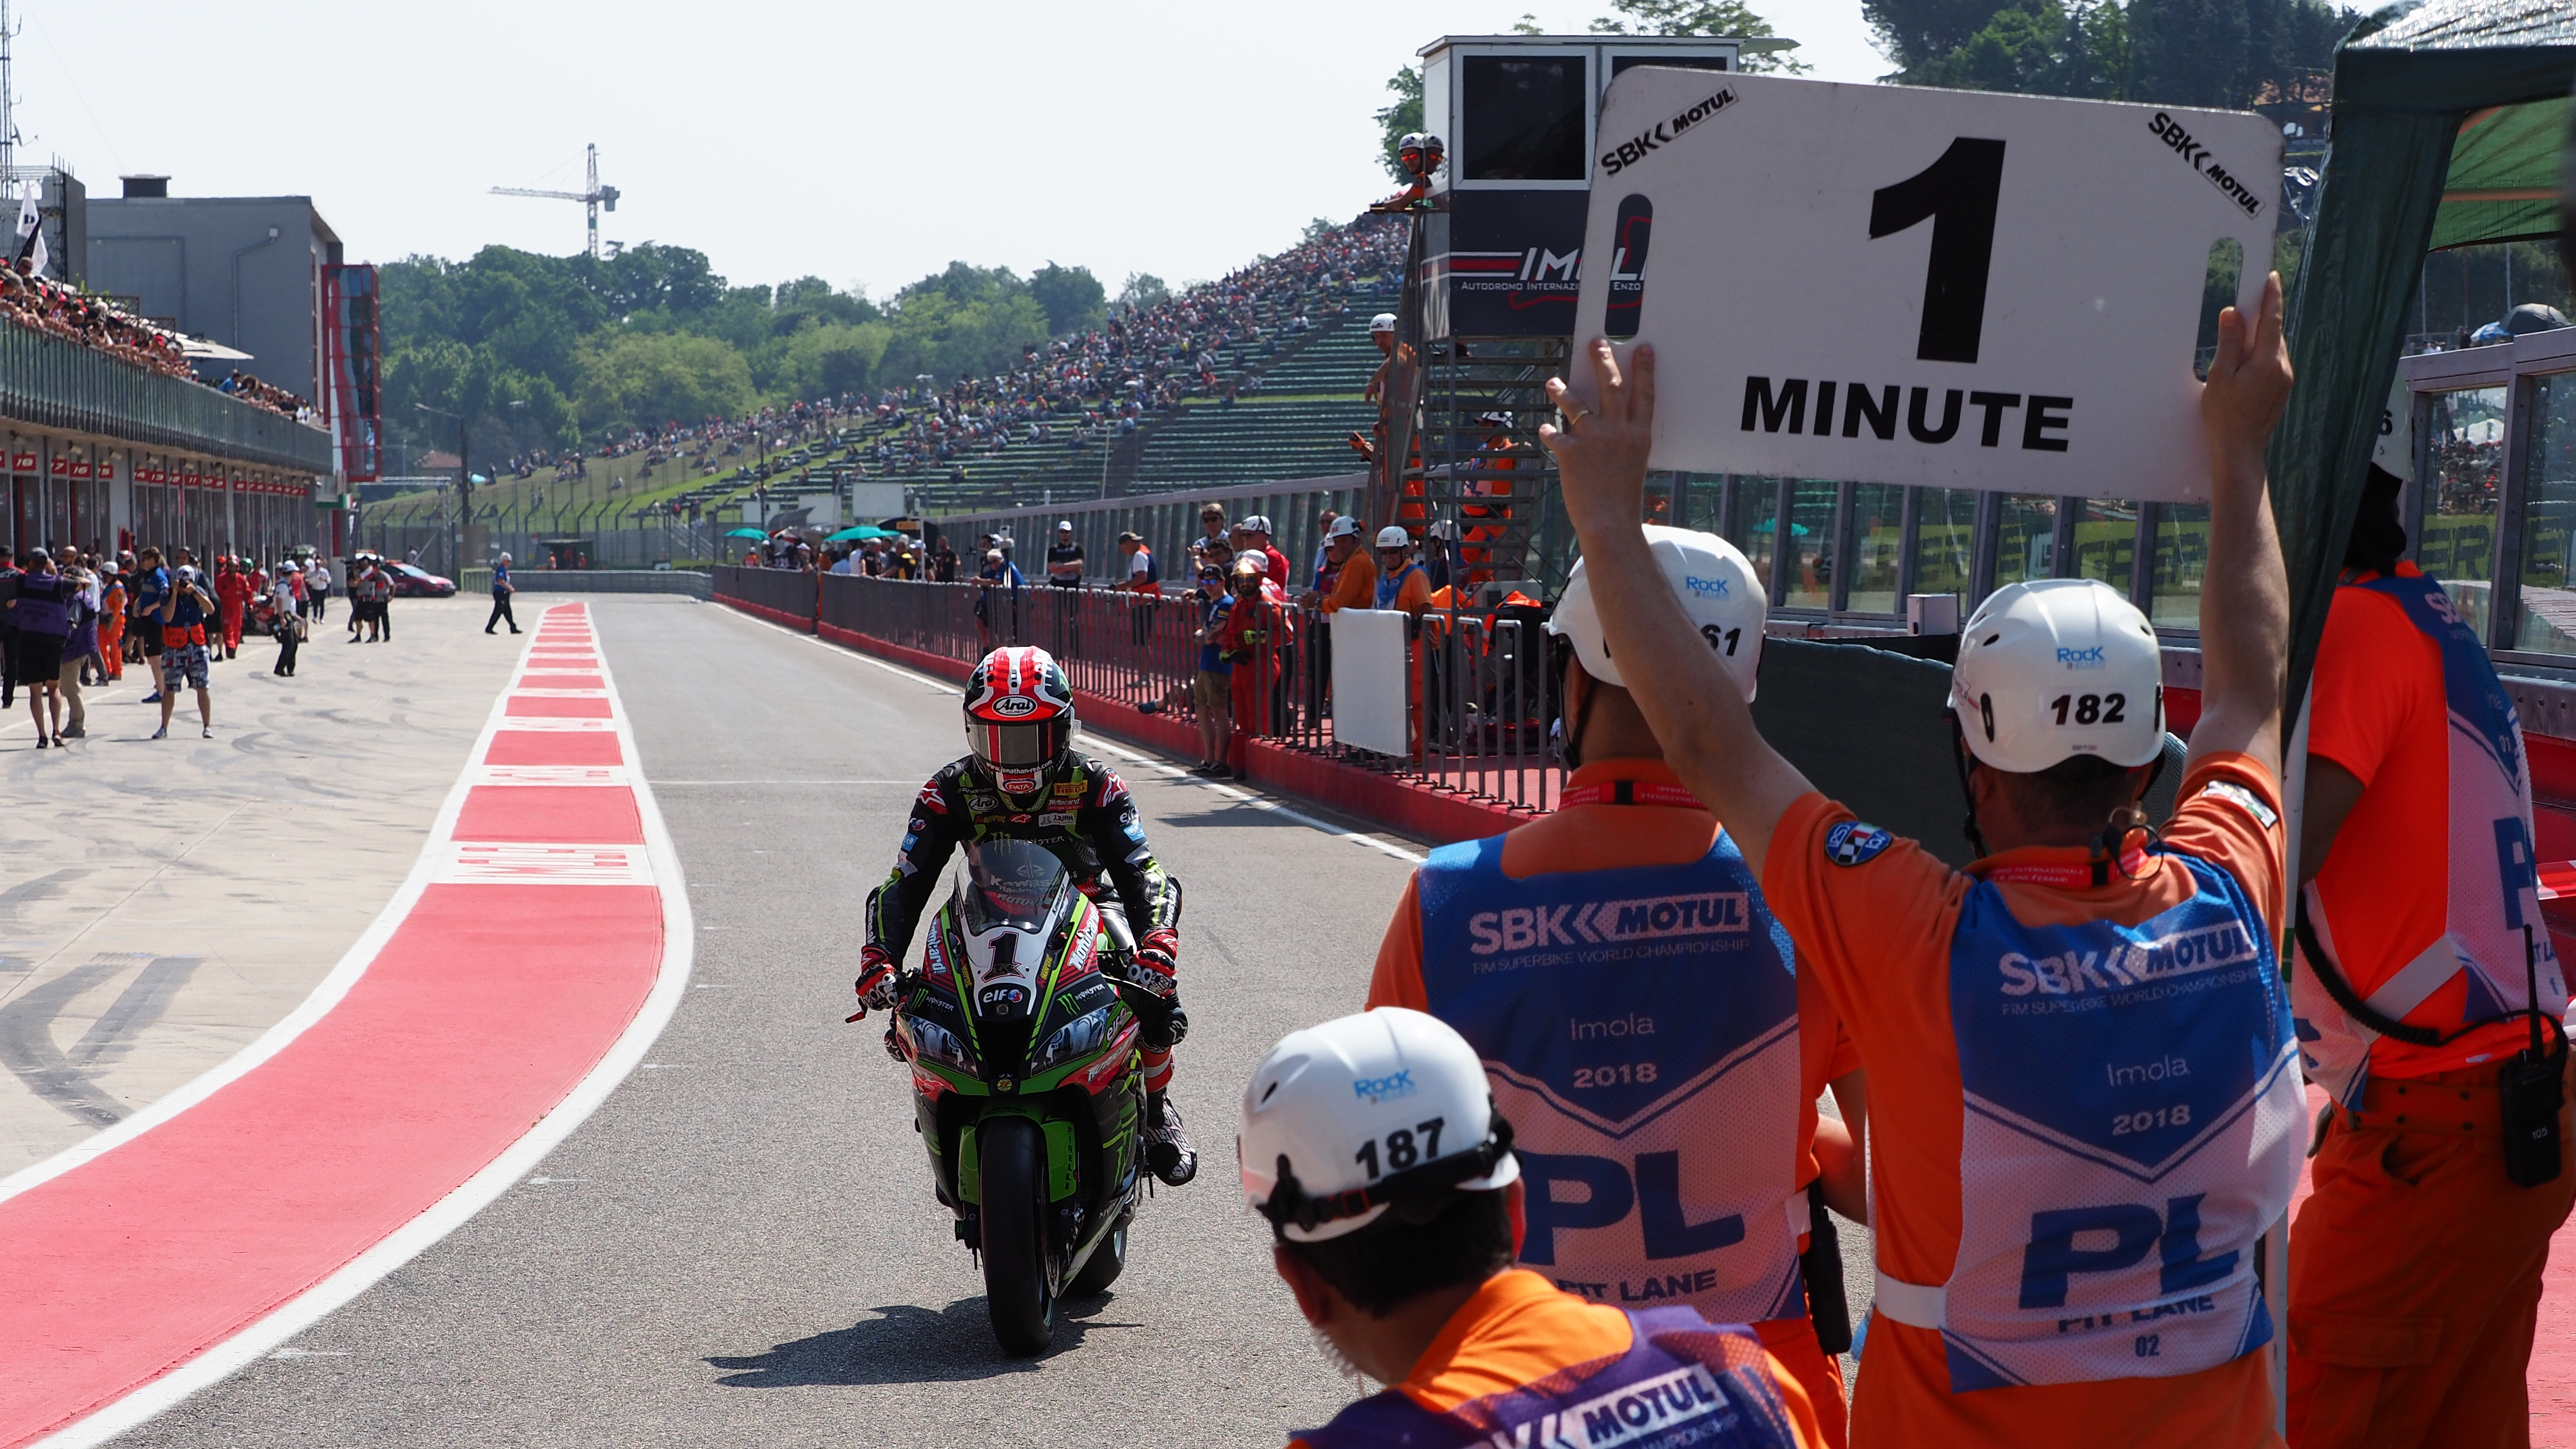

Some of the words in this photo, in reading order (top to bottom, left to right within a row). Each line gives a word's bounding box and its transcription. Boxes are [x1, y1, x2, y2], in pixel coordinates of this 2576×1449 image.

[1672, 89, 1734, 134] MOTUL
[2206, 164, 2259, 213] MOTUL
[1520, 247, 1647, 281] IML
[1868, 136, 2006, 364] 1
[1741, 376, 2073, 452] MINUTE
[2050, 692, 2126, 725] 182
[1614, 898, 1743, 934] MOTUL
[981, 931, 1026, 983] 1
[1473, 960, 1497, 975] FIM
[1498, 952, 1574, 972] SUPERBIKE
[1578, 947, 1634, 964] WORLD
[1636, 939, 1750, 959] CHAMPIONSHIP
[925, 996, 954, 1011] MONSTER
[983, 988, 1008, 1003] elf
[1074, 983, 1106, 1001] MONSTER
[2112, 989, 2164, 1007] WORLD
[1571, 1012, 1656, 1041] Imola
[1573, 1061, 1657, 1088] 2018
[2108, 1054, 2191, 1087] Imola
[2112, 1104, 2192, 1136] 2018
[1355, 1116, 1445, 1180] 187
[1517, 1149, 1745, 1266] PL
[2019, 1193, 2240, 1310] PL
[1555, 1279, 1609, 1299] PIT
[1620, 1269, 1718, 1302] LANE
[2135, 1333, 2160, 1358] 02
[1583, 1374, 1715, 1444] MOTUL
